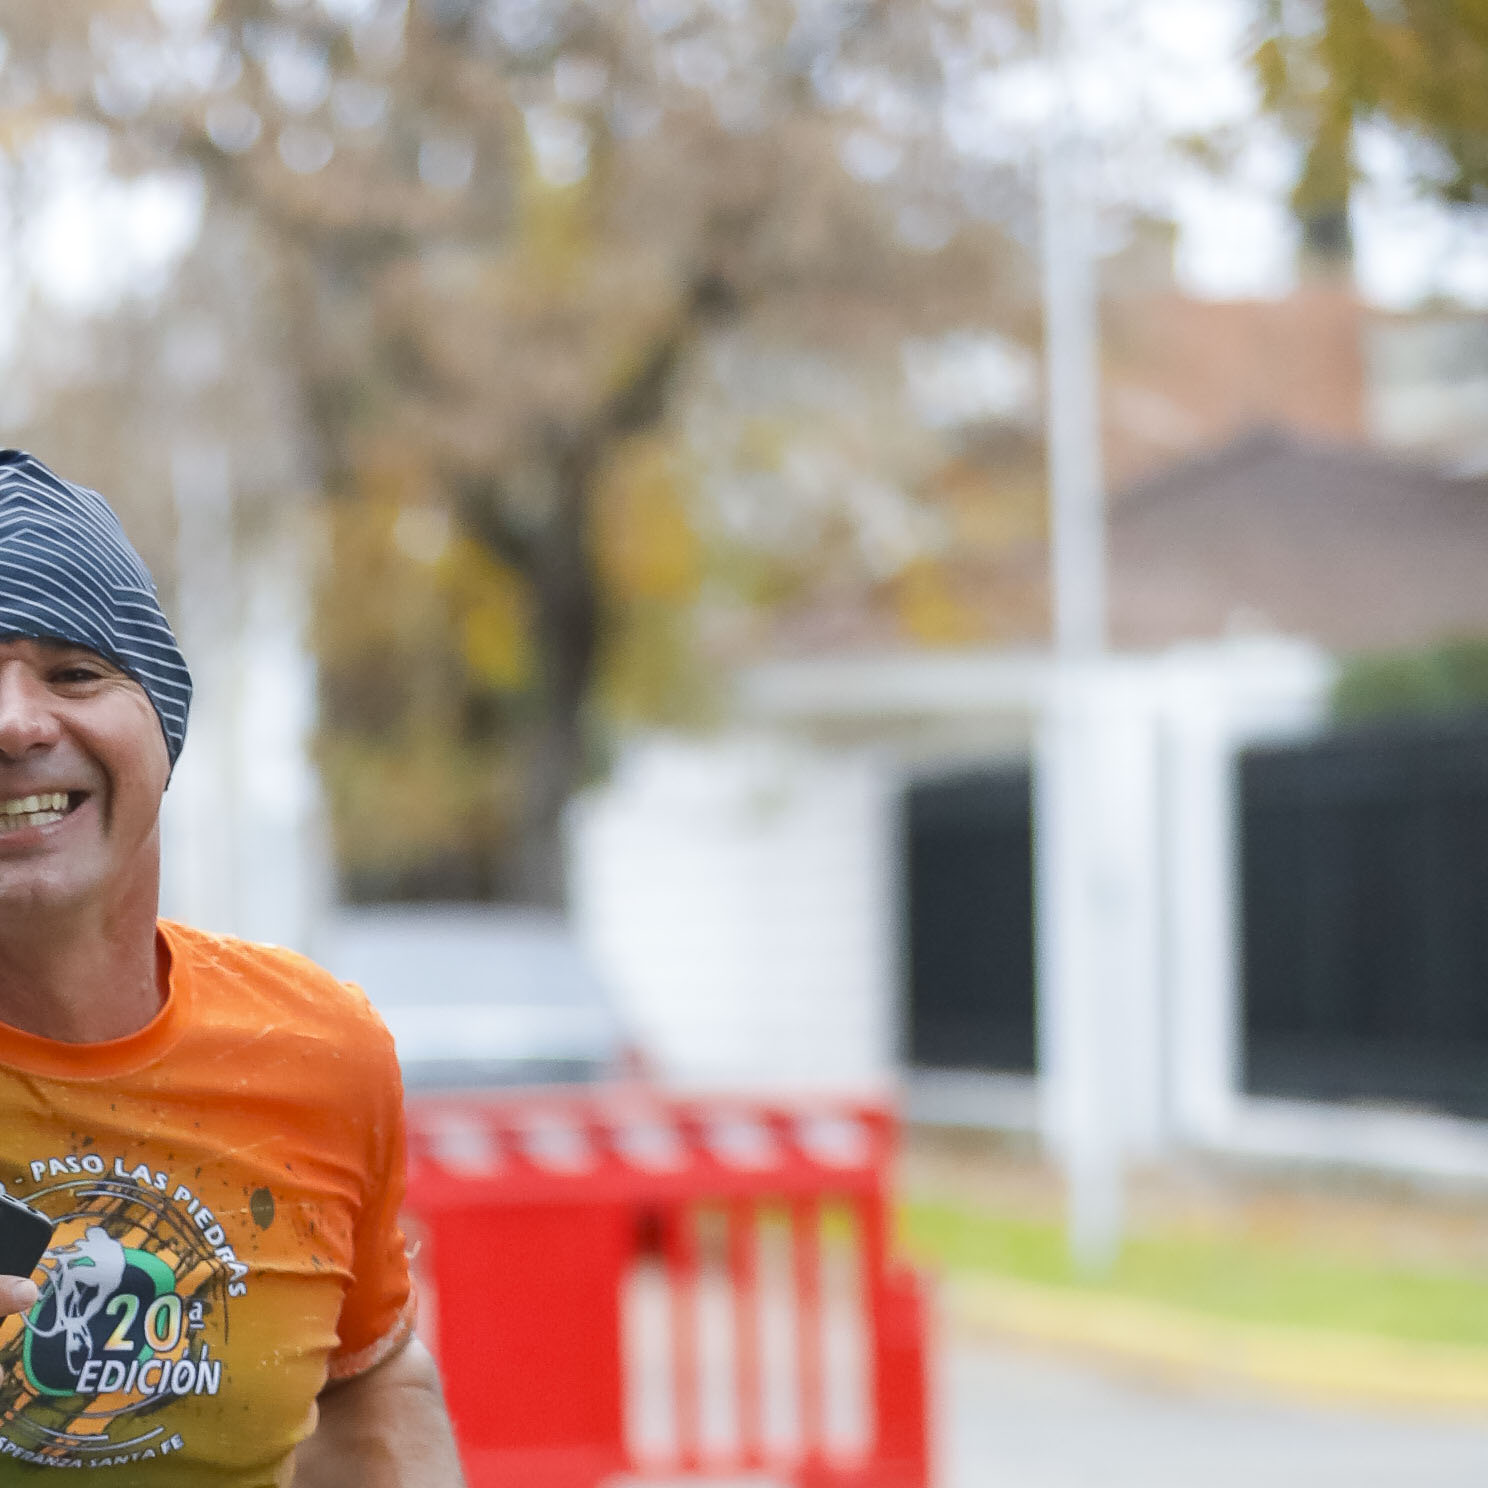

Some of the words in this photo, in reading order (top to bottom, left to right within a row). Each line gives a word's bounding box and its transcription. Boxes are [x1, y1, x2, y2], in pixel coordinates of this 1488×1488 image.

[30, 1154, 105, 1182] PASO
[114, 1157, 168, 1191] LAS
[173, 1184, 249, 1298] PIEDRAS
[160, 1433, 185, 1455] FE
